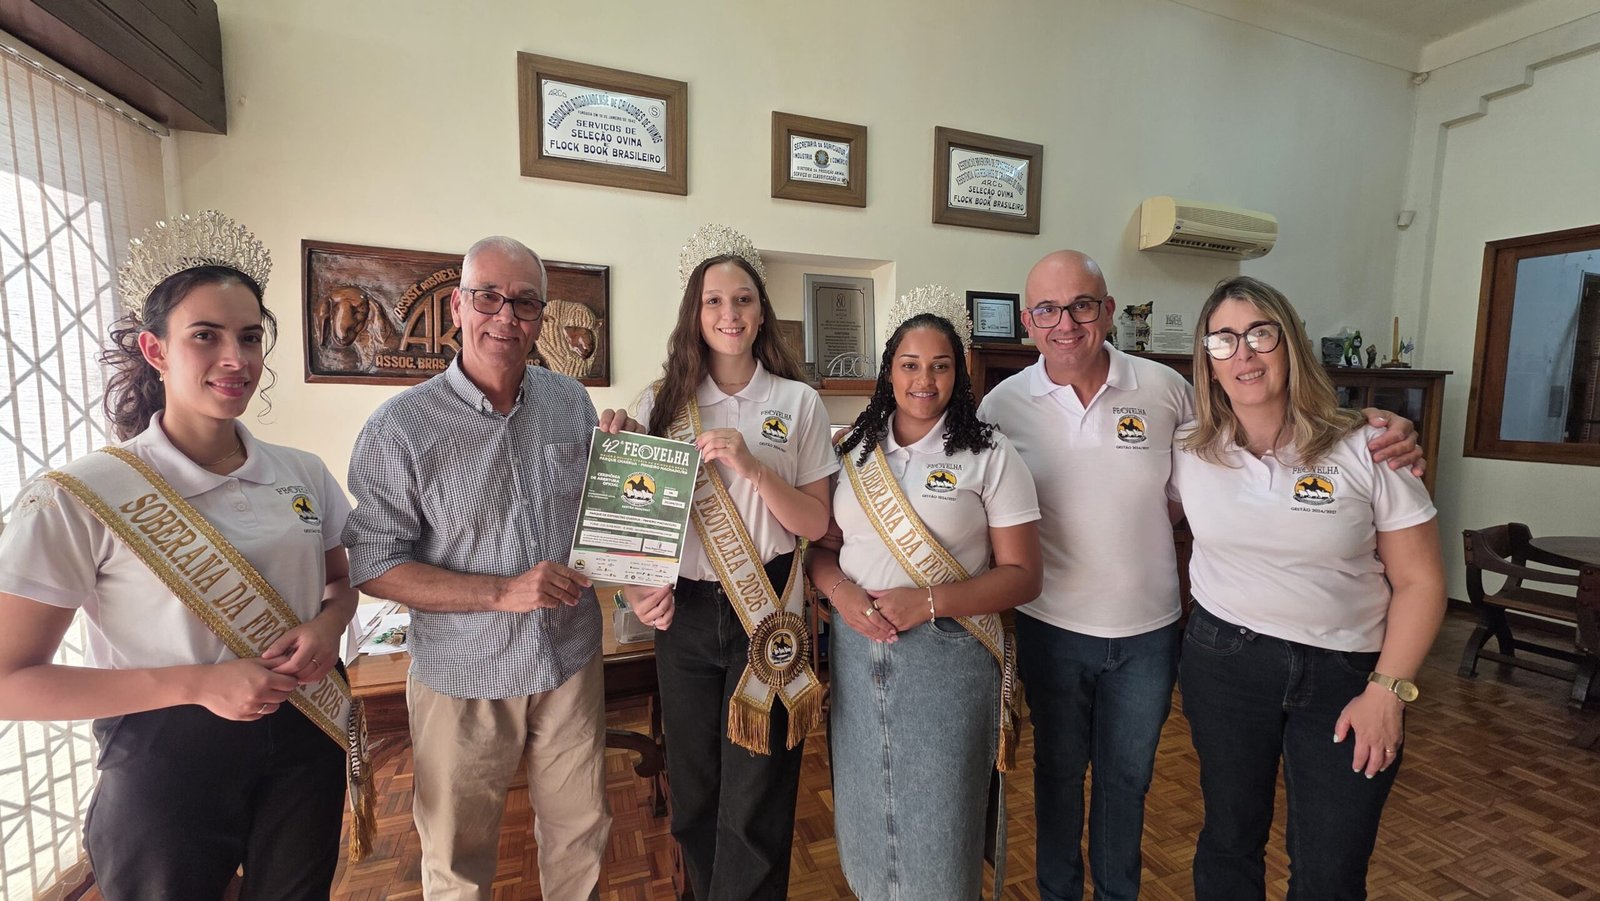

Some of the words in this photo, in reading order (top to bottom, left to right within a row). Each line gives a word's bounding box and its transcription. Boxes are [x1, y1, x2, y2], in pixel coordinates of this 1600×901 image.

[576, 119, 622, 133] SERVIÇOS
[625, 126, 637, 136] DE
[571, 129, 613, 143] SELEÇÃO
[616, 136, 642, 148] OVINA
[550, 139, 580, 152] FLOCK
[583, 144, 609, 157] BOOK
[612, 149, 661, 164] BRASILEIRO
[954, 194, 973, 204] FLOCK
[974, 198, 991, 207] BOOK
[992, 201, 1025, 212] BRASILEIRO
[997, 190, 1014, 199] OVINA
[375, 354, 416, 368] ASSOC.
[417, 356, 449, 370] BRAS.
[761, 410, 792, 421] FEOVELHA
[1112, 407, 1147, 416] FEOVELHA
[622, 441, 690, 466] FEOVELHA
[860, 460, 905, 534] SOBERANA
[896, 528, 924, 558] DA
[118, 493, 230, 594] SOBERANA
[212, 582, 256, 622] DA
[695, 493, 749, 575] FEOVELHA
[736, 572, 769, 613] 2026
[310, 676, 344, 720] 2026
